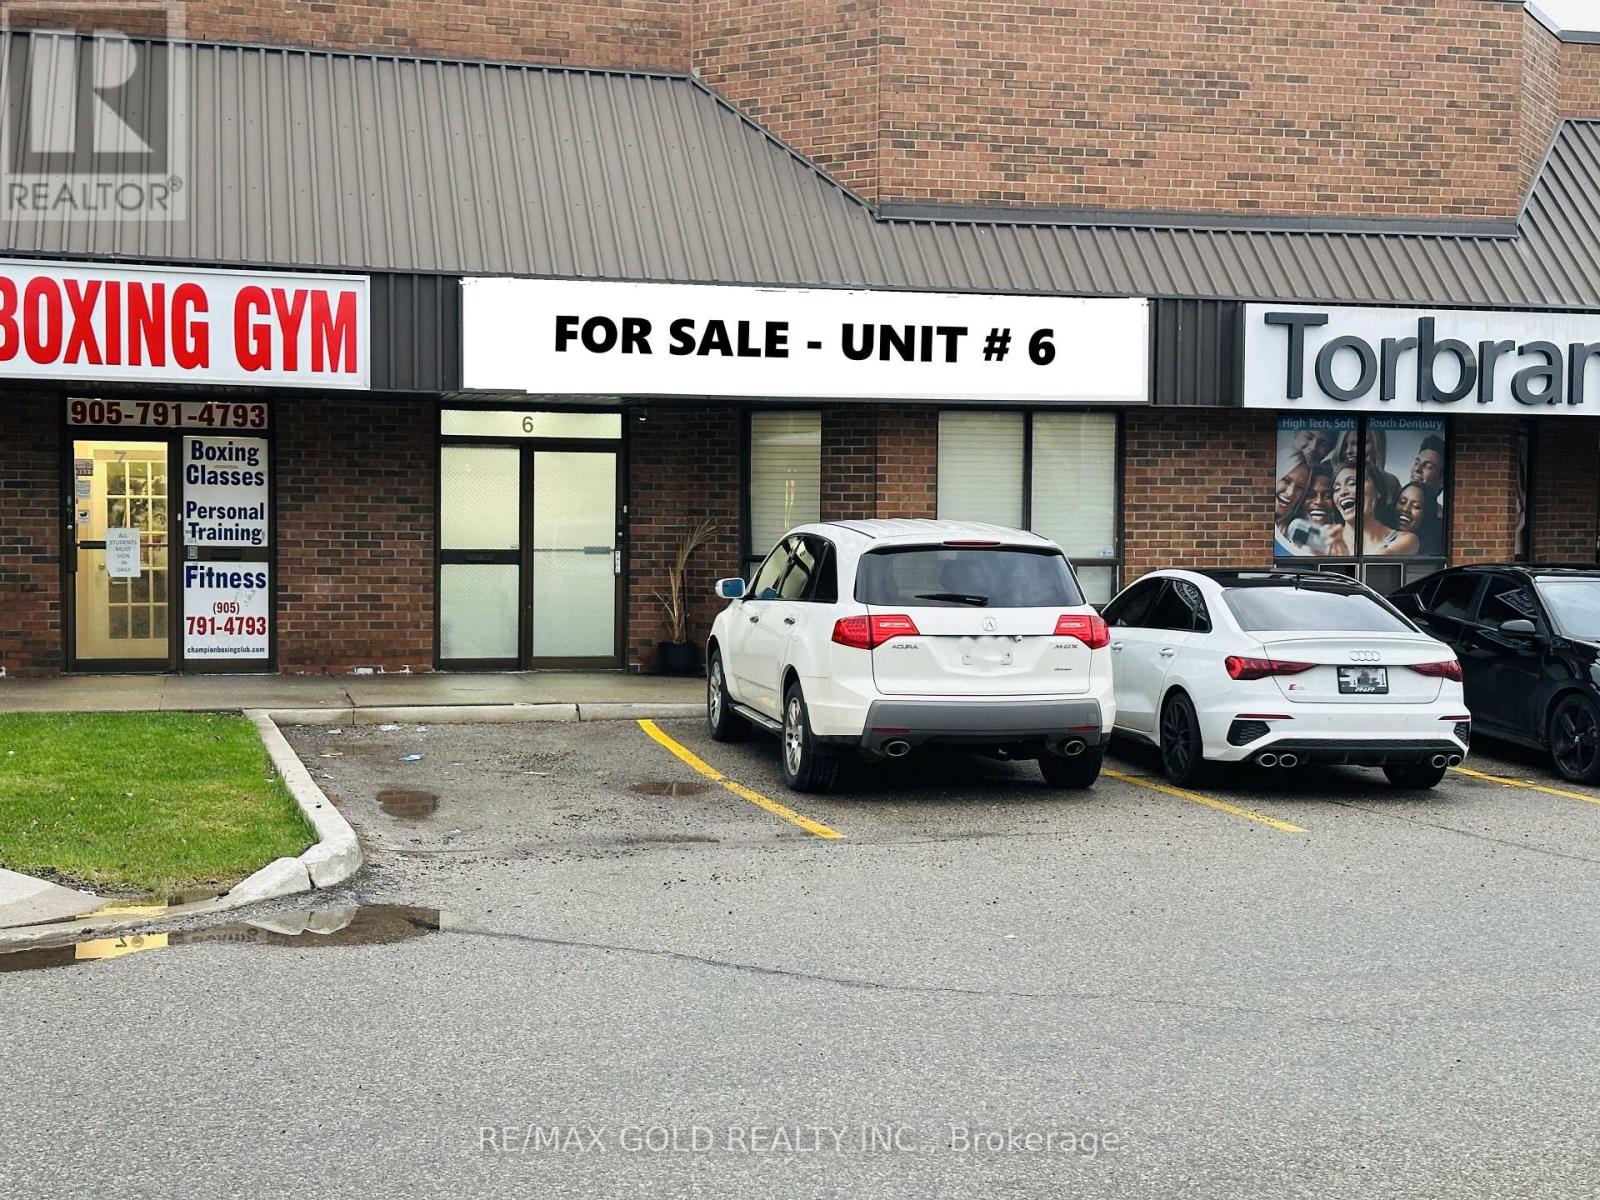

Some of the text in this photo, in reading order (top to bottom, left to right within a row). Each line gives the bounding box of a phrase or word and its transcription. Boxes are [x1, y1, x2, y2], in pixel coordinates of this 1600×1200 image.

[234, 285, 357, 373] GYM
[555, 315, 1056, 366] FOR SALE - UNIT # 6
[71, 400, 266, 428] 905-791-4793
[522, 416, 534, 433] 6
[1282, 418, 1306, 430] High
[1335, 418, 1355, 430] Soft
[1369, 418, 1397, 429] Touch
[1400, 418, 1442, 430] Dentistry
[191, 440, 259, 466] Boxing
[186, 464, 264, 486] Classes
[186, 501, 264, 520] Personal
[188, 522, 262, 545] Training
[185, 565, 267, 588] Fitness
[212, 602, 240, 615] (905)
[185, 616, 267, 636] 791-4793
[186, 646, 265, 654] championboxingclub.com
